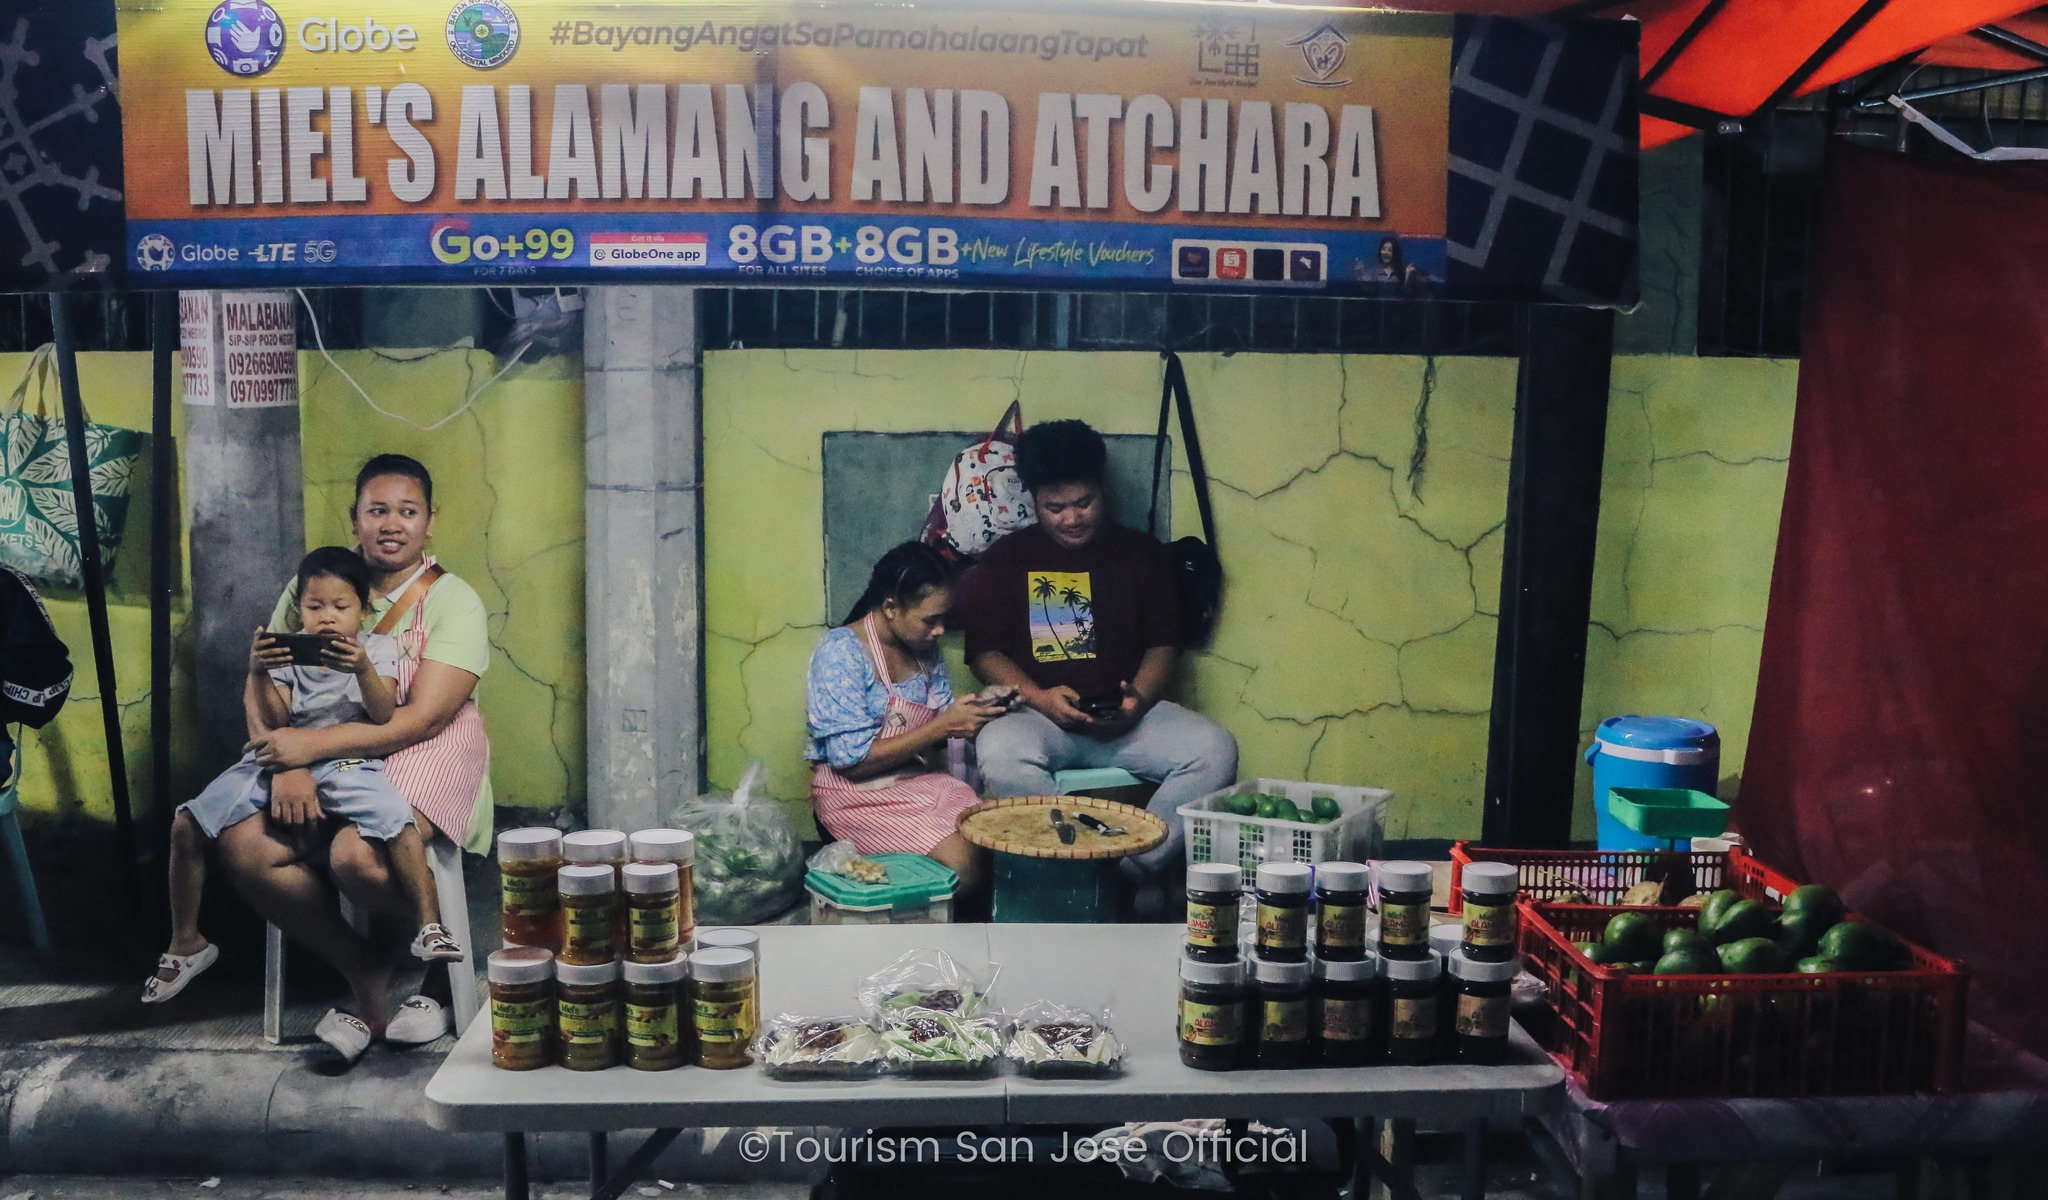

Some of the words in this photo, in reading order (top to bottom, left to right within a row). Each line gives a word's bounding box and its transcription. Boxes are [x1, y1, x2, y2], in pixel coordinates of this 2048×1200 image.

[450, 3, 467, 25] BAYAN
[501, 6, 515, 25] JOSE
[299, 17, 418, 54] Globe
[550, 20, 1147, 60] #BayangAngatSaPamahalaangTapat
[450, 41, 488, 66] OCCIDENTAL
[186, 82, 437, 206] MIEL'S
[455, 82, 831, 202] ALAMANG
[850, 86, 1010, 205] AND
[1029, 91, 1381, 219] ATCHARA
[181, 244, 239, 262] Globe
[248, 242, 297, 262] LTE
[304, 240, 337, 263] 5G
[430, 217, 575, 264] Go+99
[611, 248, 672, 260] GlobeOne
[677, 251, 701, 262] app
[1012, 236, 1082, 270] Lifestyle
[1089, 240, 1154, 267] Vouchers
[474, 266, 495, 277] FOR
[499, 266, 505, 276] 7
[508, 266, 536, 276] DAYS
[738, 265, 764, 277] FOR
[767, 265, 788, 276] ALL
[791, 265, 827, 276] SITES
[855, 266, 904, 278] CHOICE
[907, 267, 924, 278] OF
[927, 268, 959, 279] APPS
[259, 333, 278, 346] POZO
